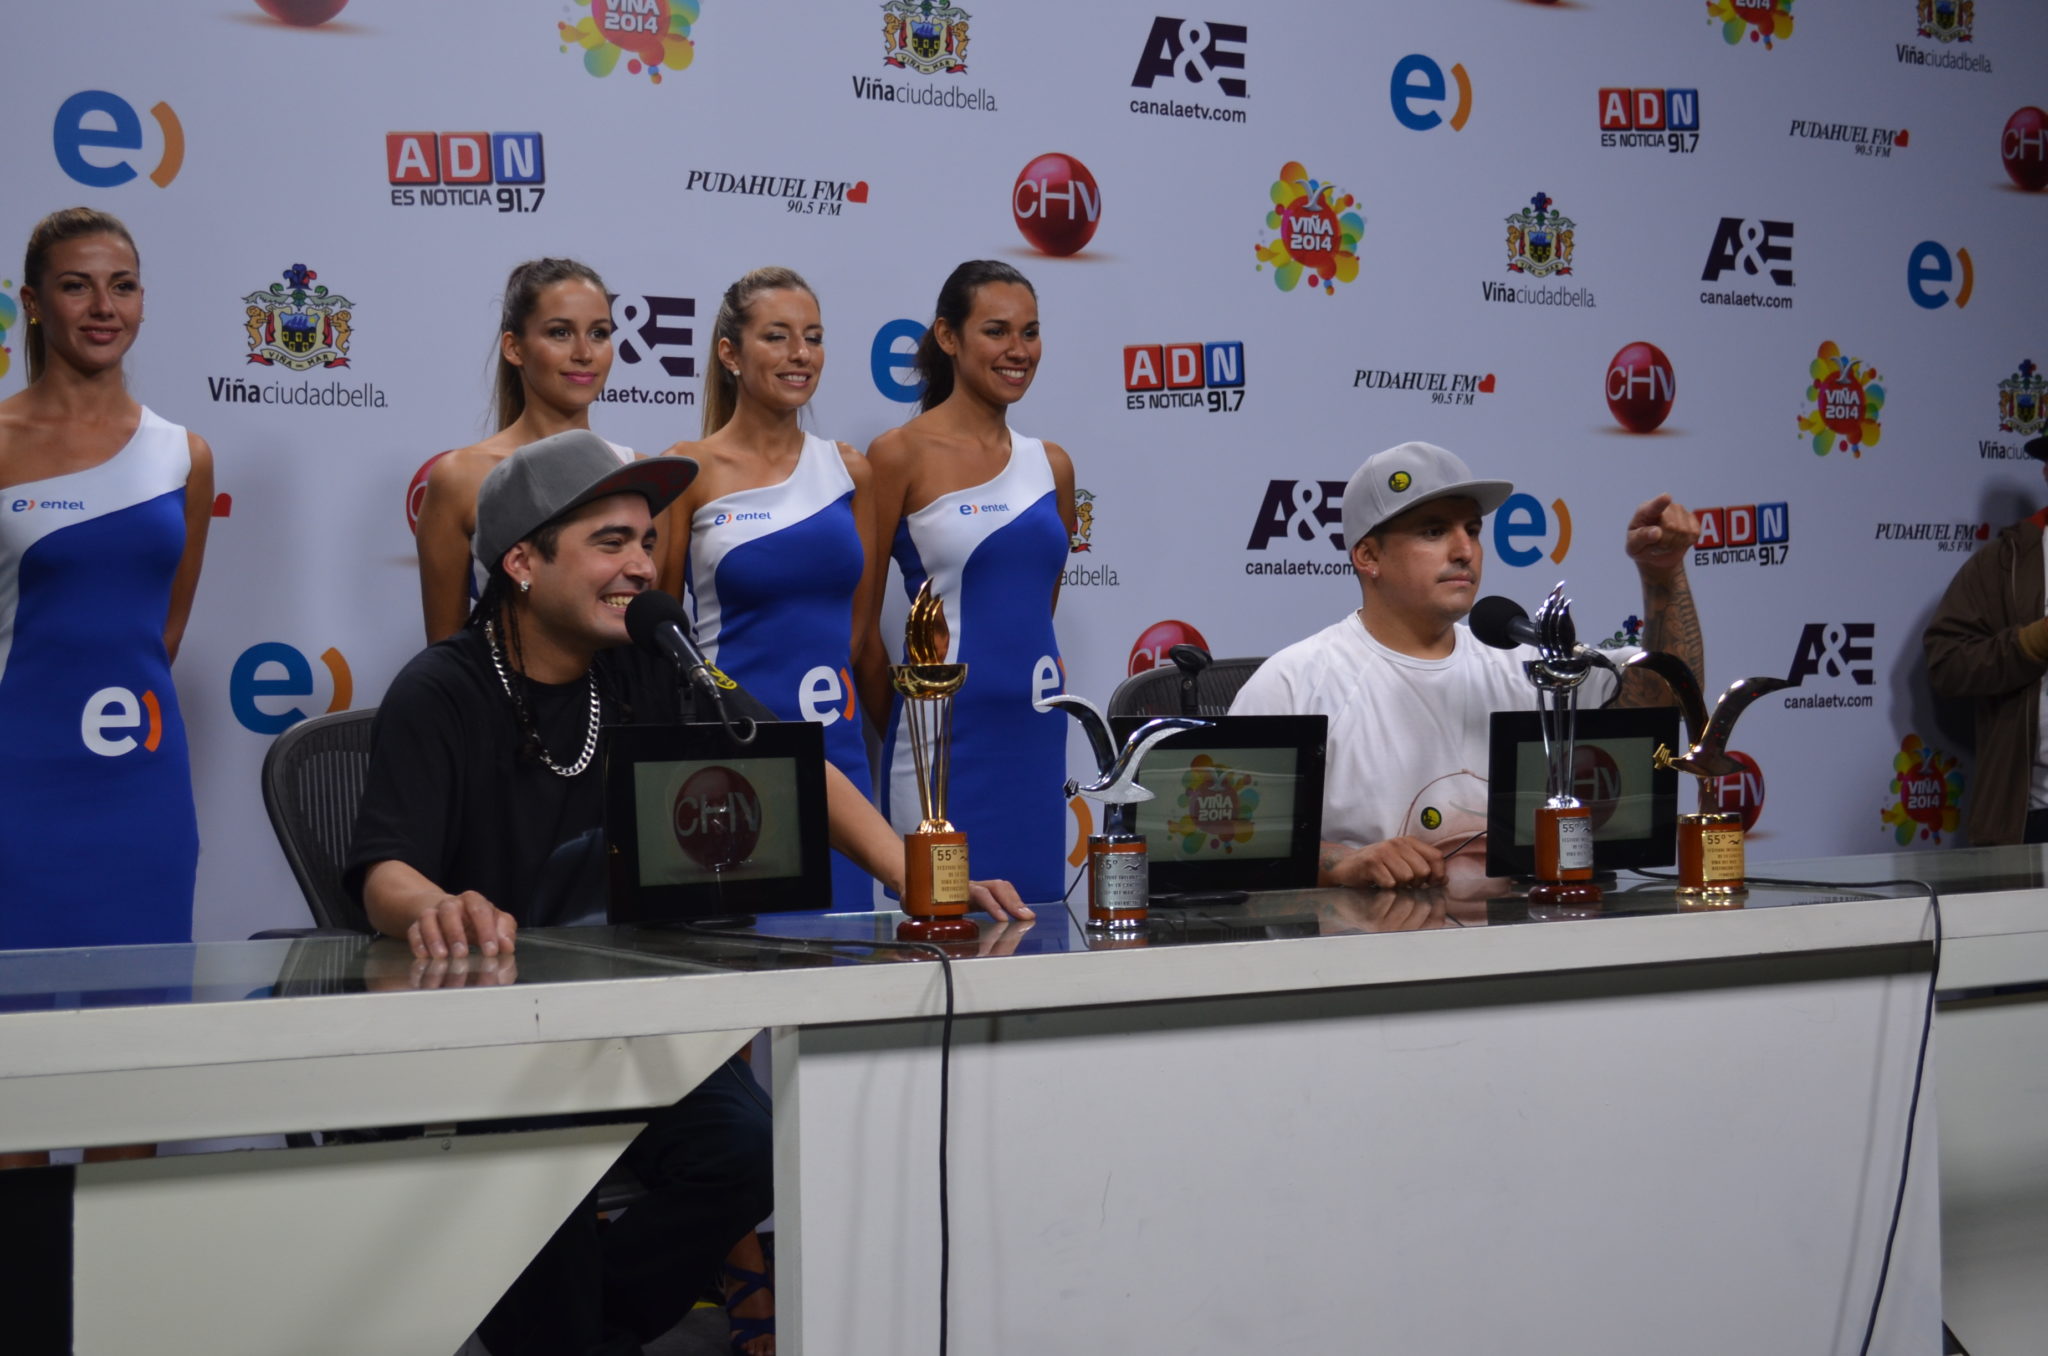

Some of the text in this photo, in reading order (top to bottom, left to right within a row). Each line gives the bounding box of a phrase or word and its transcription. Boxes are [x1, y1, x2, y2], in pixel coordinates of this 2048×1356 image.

[605, 12, 658, 34] 2014
[1131, 16, 1248, 98] A&E
[1130, 99, 1247, 124] canalaetv.com
[1603, 91, 1694, 128] ADN
[1601, 133, 1699, 153] ES NOTICIA 91.7
[1789, 119, 1896, 147] PUDAHUEL FM
[1854, 144, 1892, 159] 90.5 FM
[2003, 127, 2048, 161] CH
[394, 136, 537, 180] ADN
[686, 169, 847, 201] PUDAHUEL FM
[391, 188, 546, 213] ES NOTICIA 91.7
[786, 199, 842, 216] 90.5 FM
[1013, 178, 1099, 222] CHV
[1289, 215, 1334, 235] VIÑA
[1290, 232, 1333, 252] 2014
[1701, 217, 1794, 286] A&E
[1700, 289, 1793, 309] canalaetv.com
[607, 294, 696, 378] &E
[1129, 346, 1240, 387] ADN
[1353, 369, 1479, 394] PUDAHUEL FM
[1606, 363, 1676, 402] CHV
[600, 386, 695, 405] laetv.com
[1127, 390, 1245, 413] ES NOTICIA 91.7
[1431, 391, 1475, 405] 90.5 FM
[1824, 387, 1861, 407] VIÑA
[1824, 405, 1860, 420] 2014
[40, 498, 86, 511] entel
[981, 502, 1010, 513] entel
[735, 510, 772, 522] entel
[1697, 505, 1785, 545] ADN
[1875, 522, 1978, 541] PUDAHUEL FM
[1694, 545, 1789, 566] ES NOTICIA 91.7
[1937, 541, 1973, 552] 90.5 FM
[1245, 559, 1357, 576] canalaetv.com
[1788, 623, 1876, 686] A&E
[1784, 694, 1873, 710] canalaetv.com
[1718, 771, 1763, 808] HV
[1908, 795, 1940, 809] 2014
[676, 791, 760, 837] CHV
[1197, 808, 1233, 822] 2014
